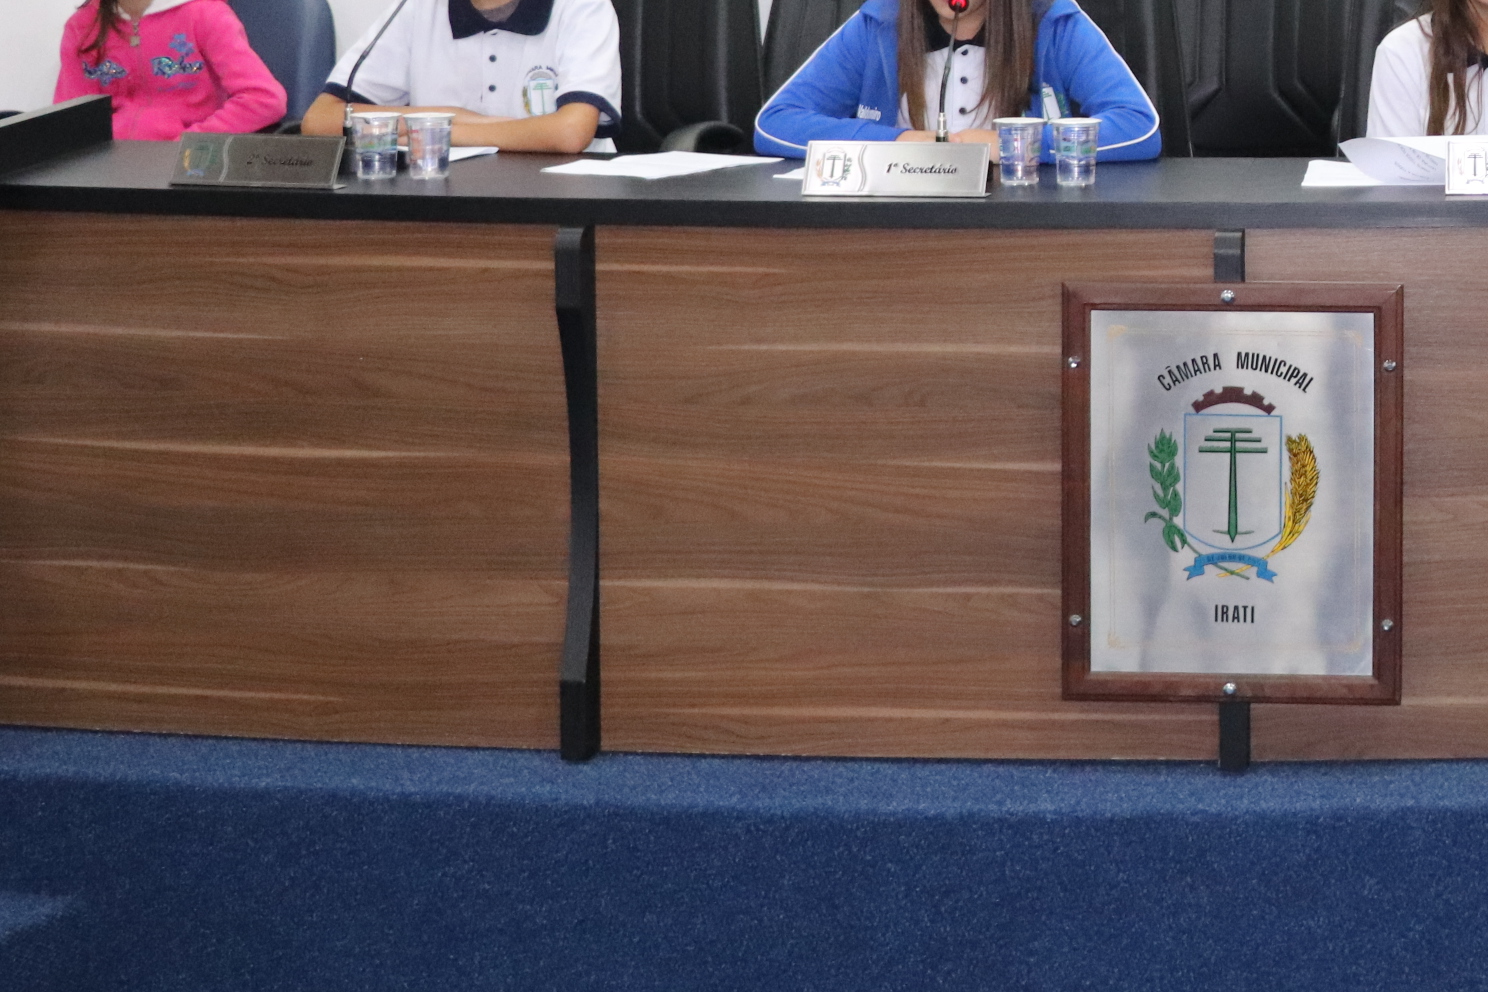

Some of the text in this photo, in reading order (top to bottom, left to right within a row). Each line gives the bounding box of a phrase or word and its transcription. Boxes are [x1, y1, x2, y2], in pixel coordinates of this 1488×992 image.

[900, 162, 957, 174] Secretário
[1157, 351, 1314, 394] CÂMARA MUNICIPAL
[1214, 604, 1255, 624] IRATI
